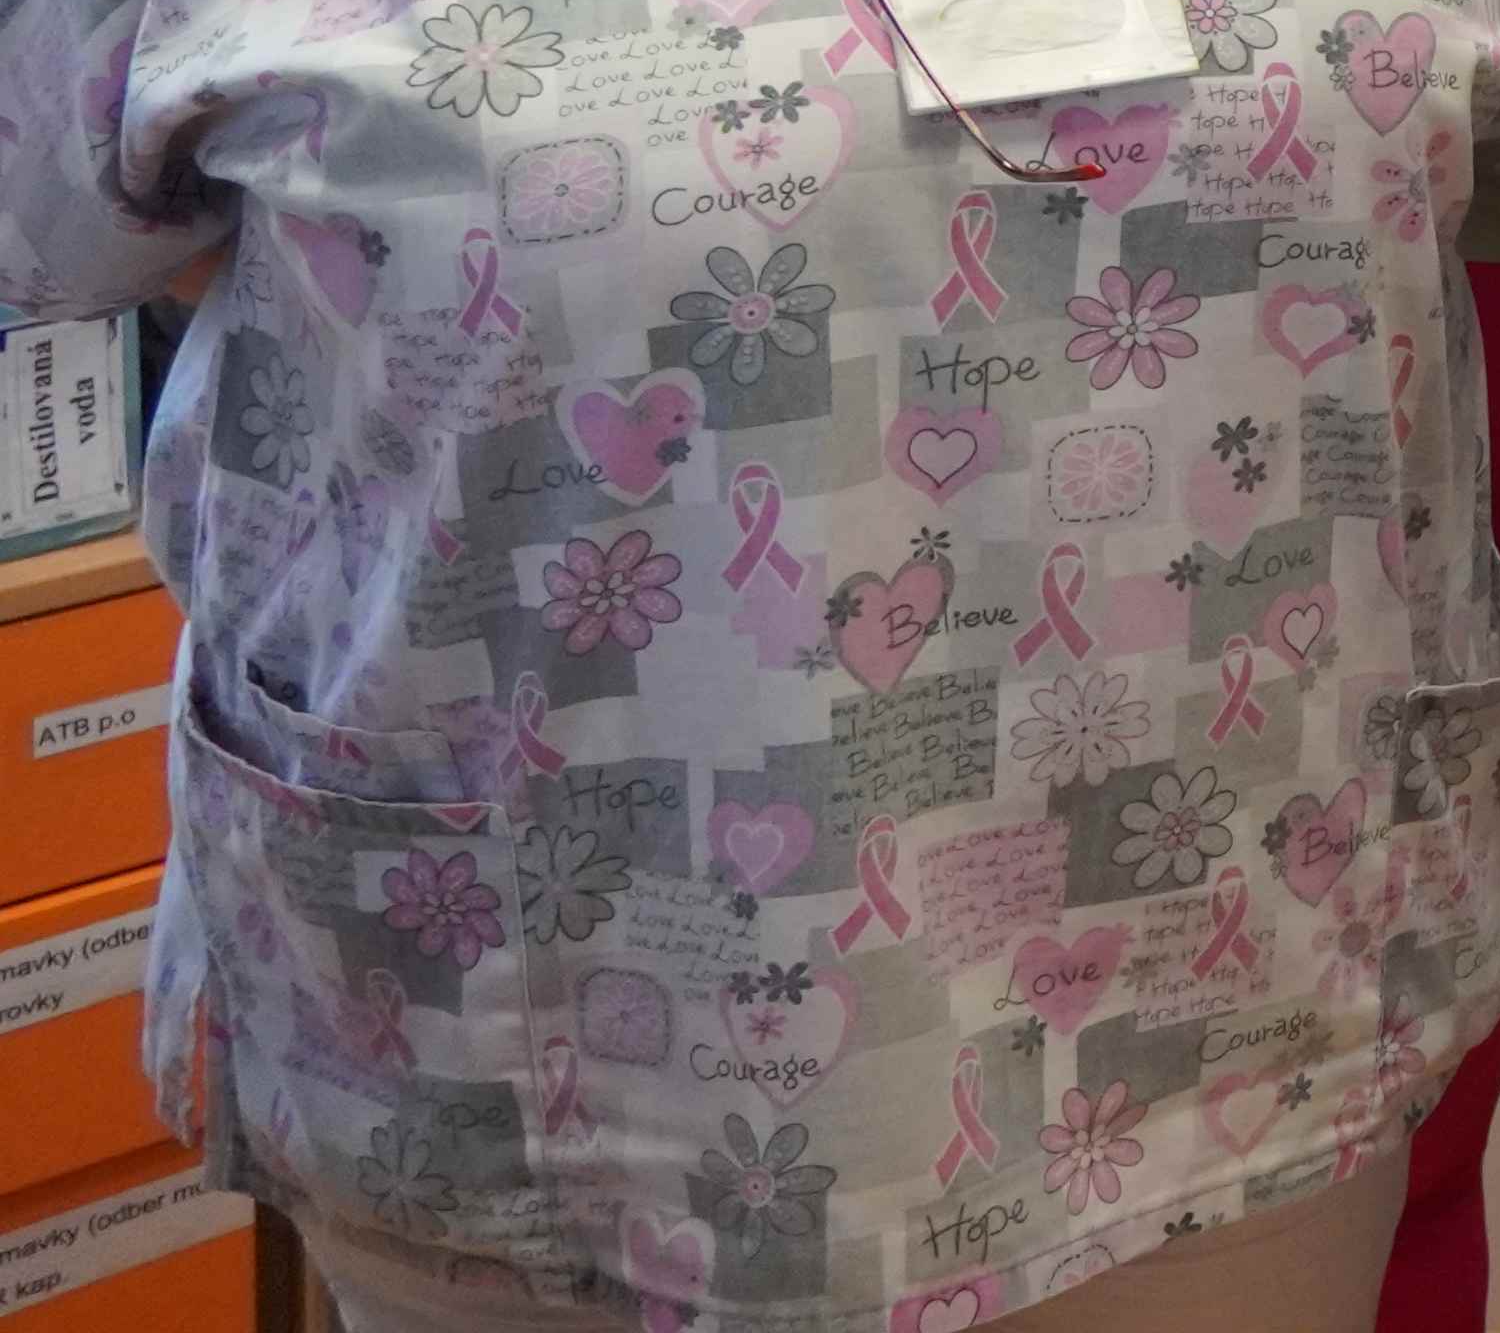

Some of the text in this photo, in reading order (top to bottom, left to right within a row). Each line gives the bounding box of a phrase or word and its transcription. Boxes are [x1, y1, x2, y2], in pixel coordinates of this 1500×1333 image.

[620, 39, 689, 61] Love
[1366, 49, 1461, 93] Believe
[565, 70, 633, 93] Love
[643, 58, 712, 81] Love
[608, 86, 676, 109] Love
[651, 173, 819, 228] Courage
[1257, 233, 1371, 270] Courag
[916, 342, 1041, 414] Hope
[28, 338, 59, 505] Destilovaná
[69, 376, 97, 446] voda
[490, 458, 609, 502] Love
[1224, 544, 1315, 589] Love
[880, 602, 1019, 650] Believe
[38, 715, 91, 748] ATB
[561, 768, 683, 833] Hope
[1299, 824, 1391, 868] Believe
[81, 923, 154, 961] (odbe
[992, 960, 1102, 1013] Love
[1199, 1009, 1319, 1063] Courage
[689, 1042, 821, 1091] Courage
[87, 1191, 165, 1234] (odber
[924, 1193, 1032, 1262] Hope
